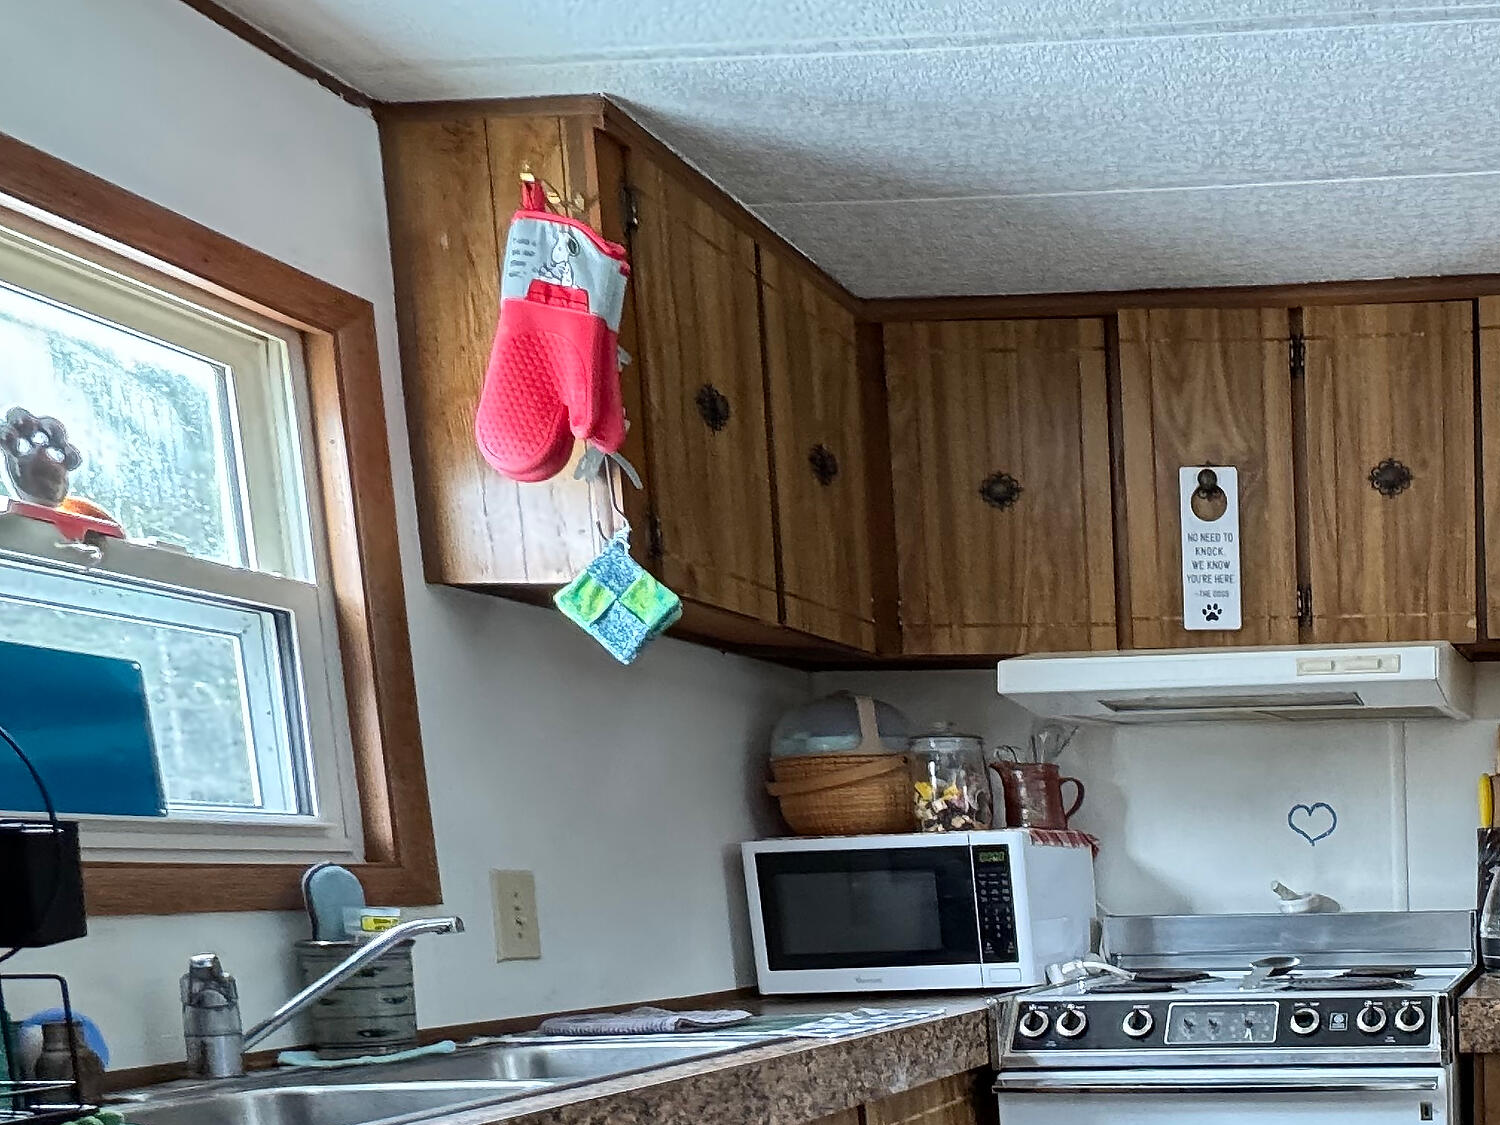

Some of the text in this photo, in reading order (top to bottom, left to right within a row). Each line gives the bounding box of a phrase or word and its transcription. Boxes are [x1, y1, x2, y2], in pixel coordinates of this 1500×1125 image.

[1187, 532, 1233, 543] NO NEED TO
[1191, 560, 1231, 570] WE KNOW
